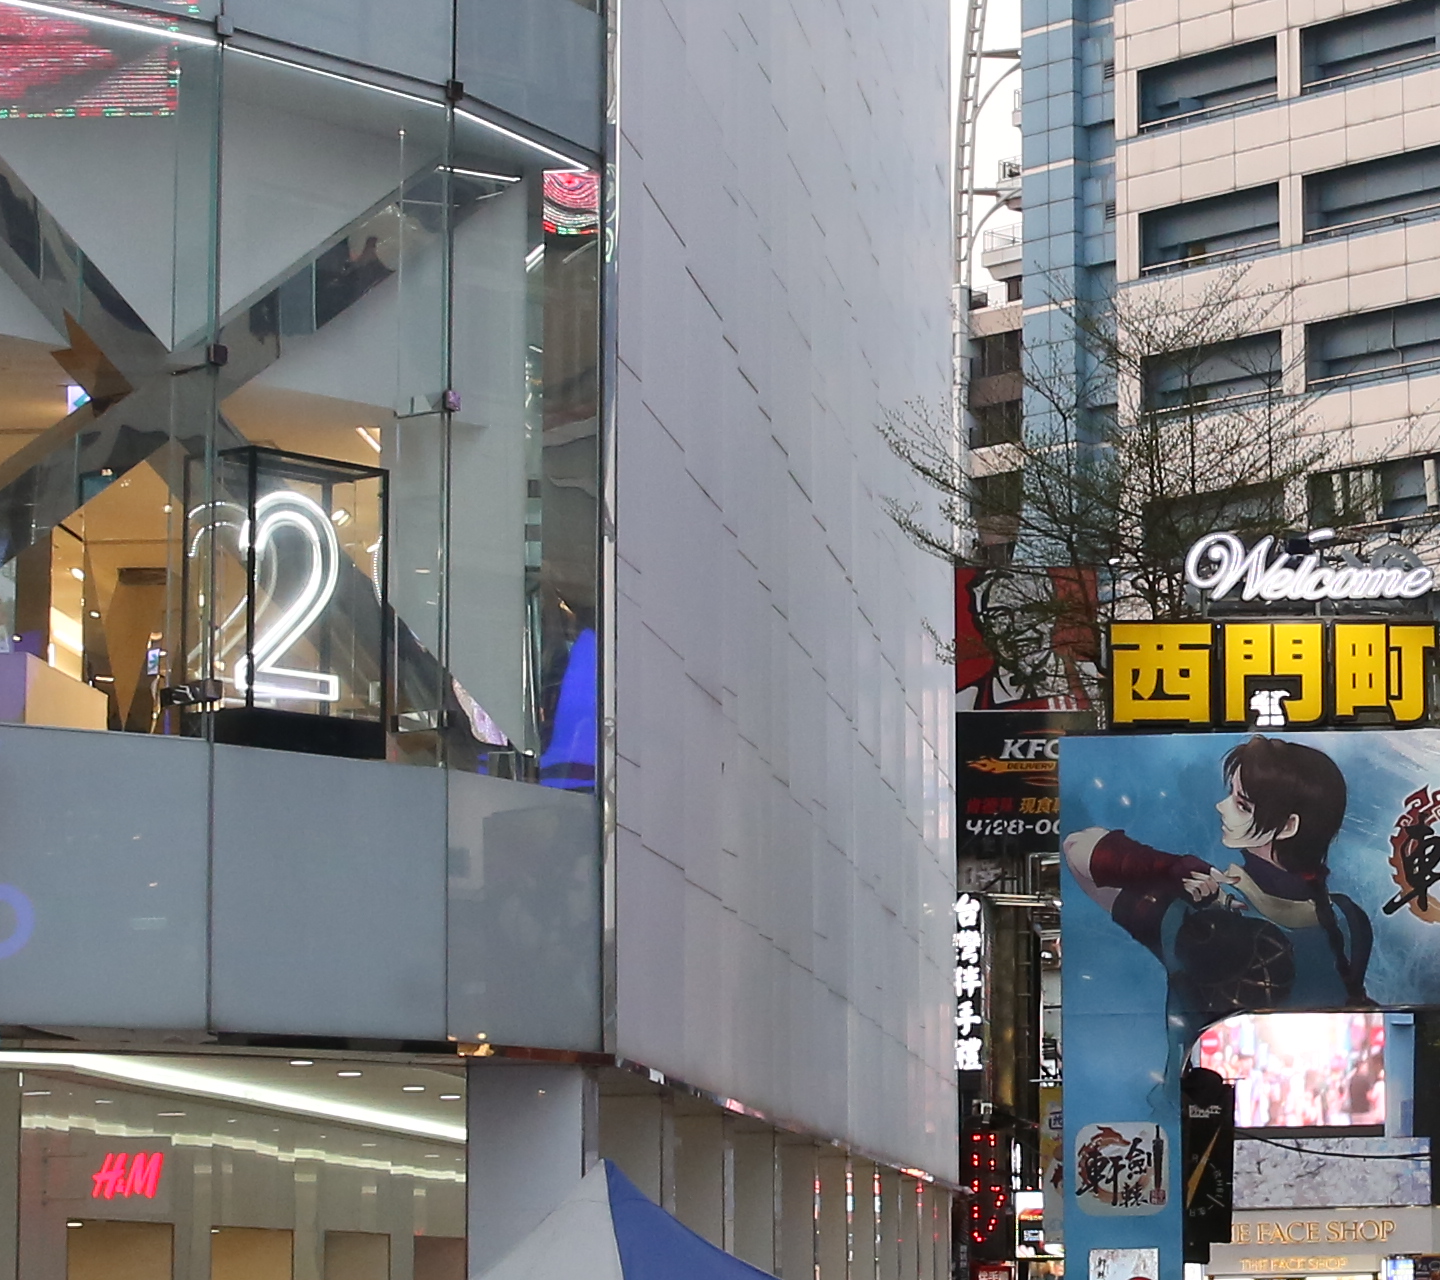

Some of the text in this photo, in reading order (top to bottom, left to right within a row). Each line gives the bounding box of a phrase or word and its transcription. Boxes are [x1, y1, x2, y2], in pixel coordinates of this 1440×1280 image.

[1185, 529, 1434, 601] Welcome
[1111, 621, 1437, 726] 西門町
[92, 1152, 163, 1200] H&M
[1257, 1221, 1321, 1244] FACE
[1325, 1219, 1396, 1243] SHOP
[1240, 1257, 1348, 1272] THE FACE SHOP
